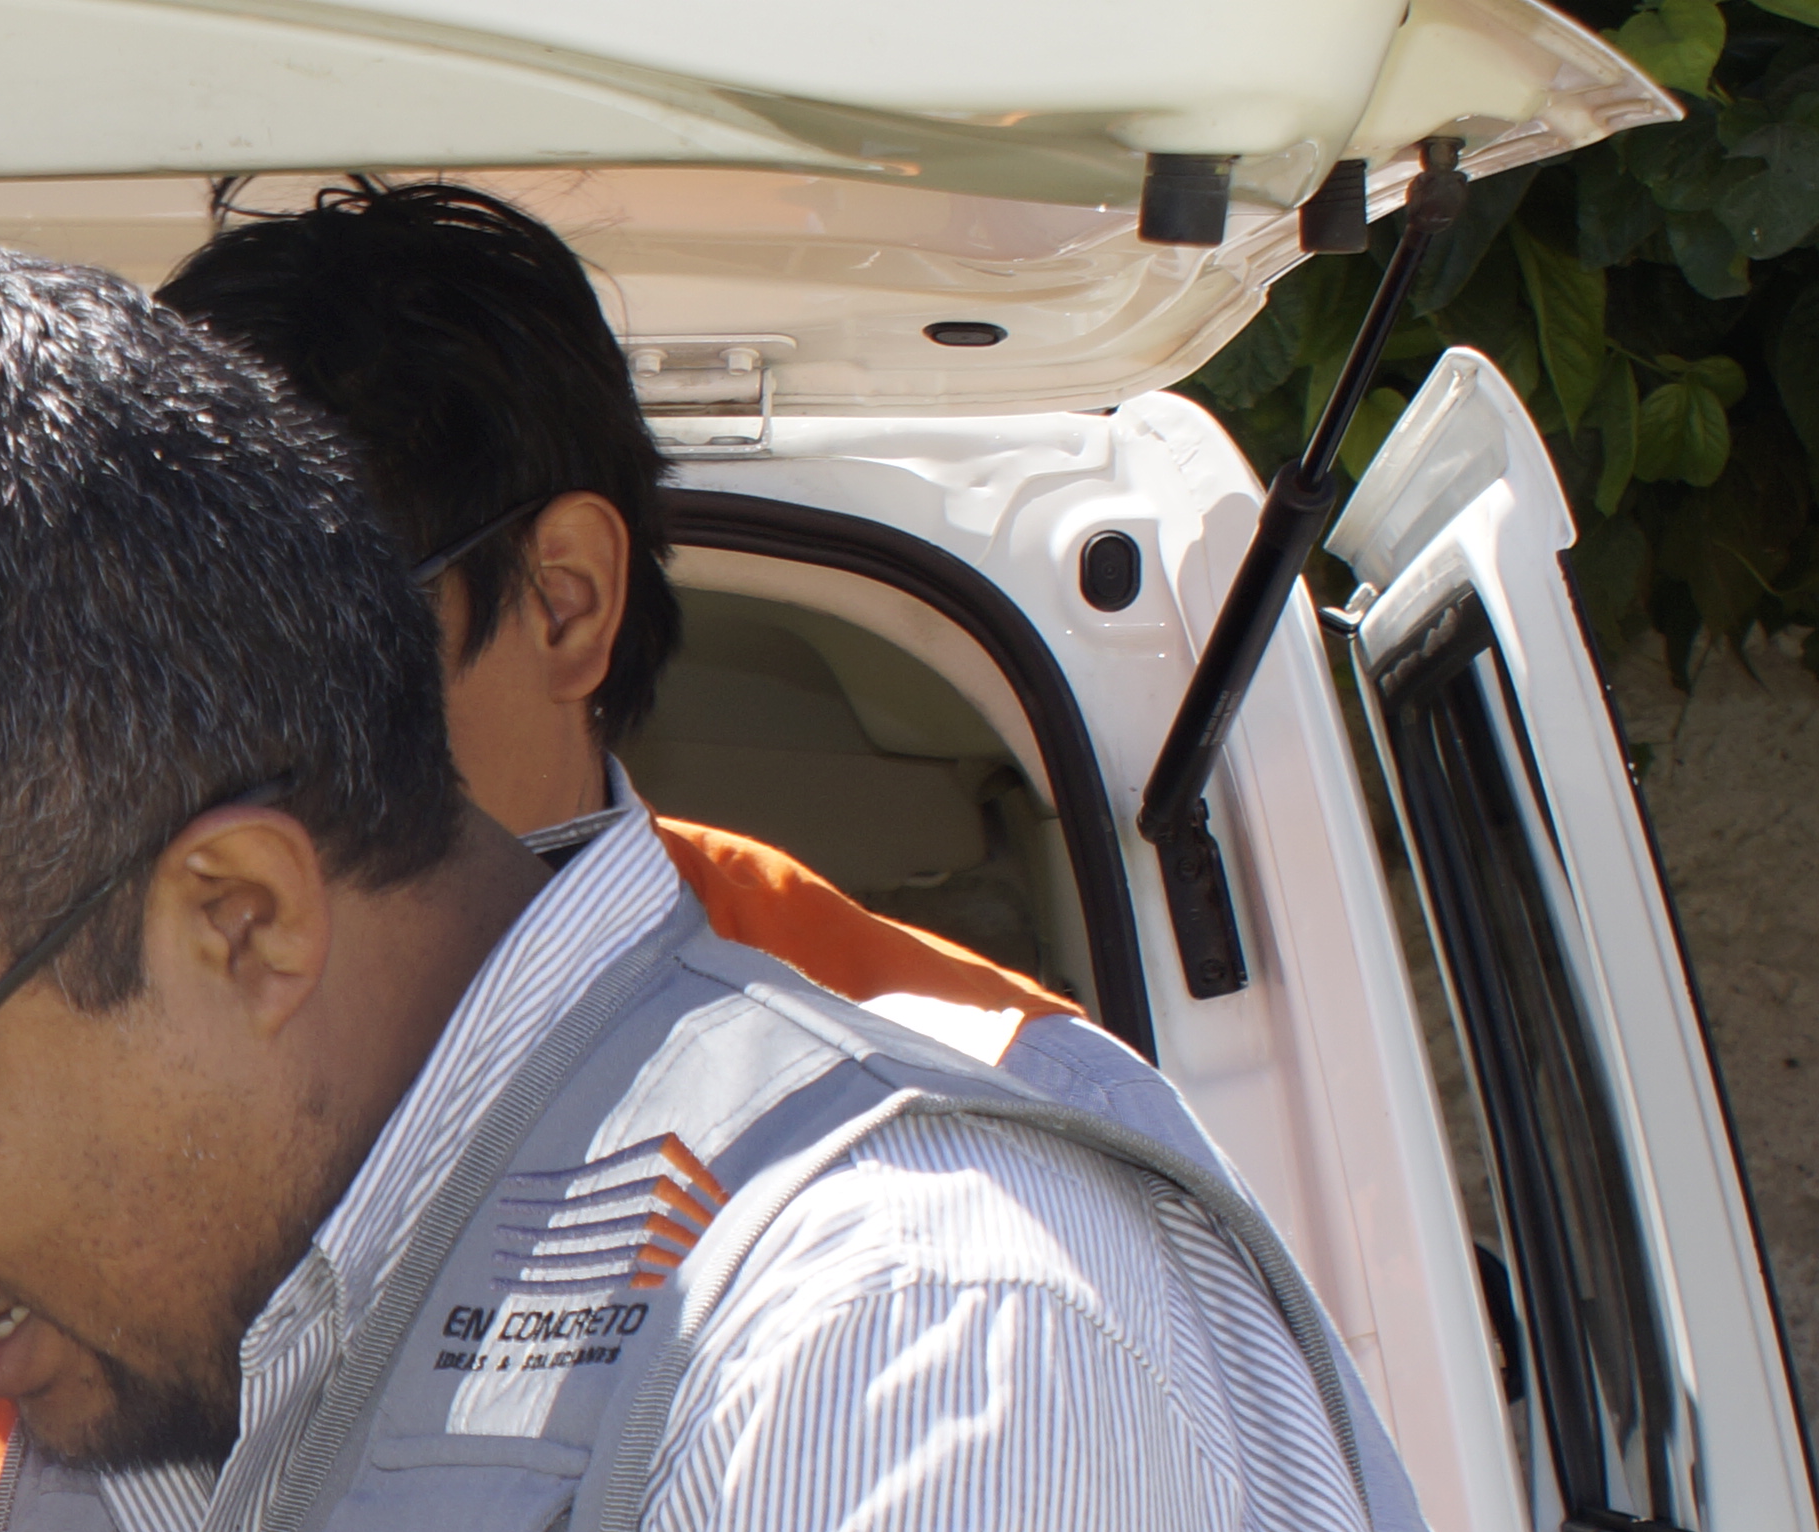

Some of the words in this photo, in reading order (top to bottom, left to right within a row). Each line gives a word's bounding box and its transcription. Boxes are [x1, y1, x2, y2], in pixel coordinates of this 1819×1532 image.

[443, 1305, 496, 1341] EN
[497, 1302, 649, 1341] CONCRETO
[432, 1349, 488, 1371] IDEAS
[495, 1355, 511, 1371] &
